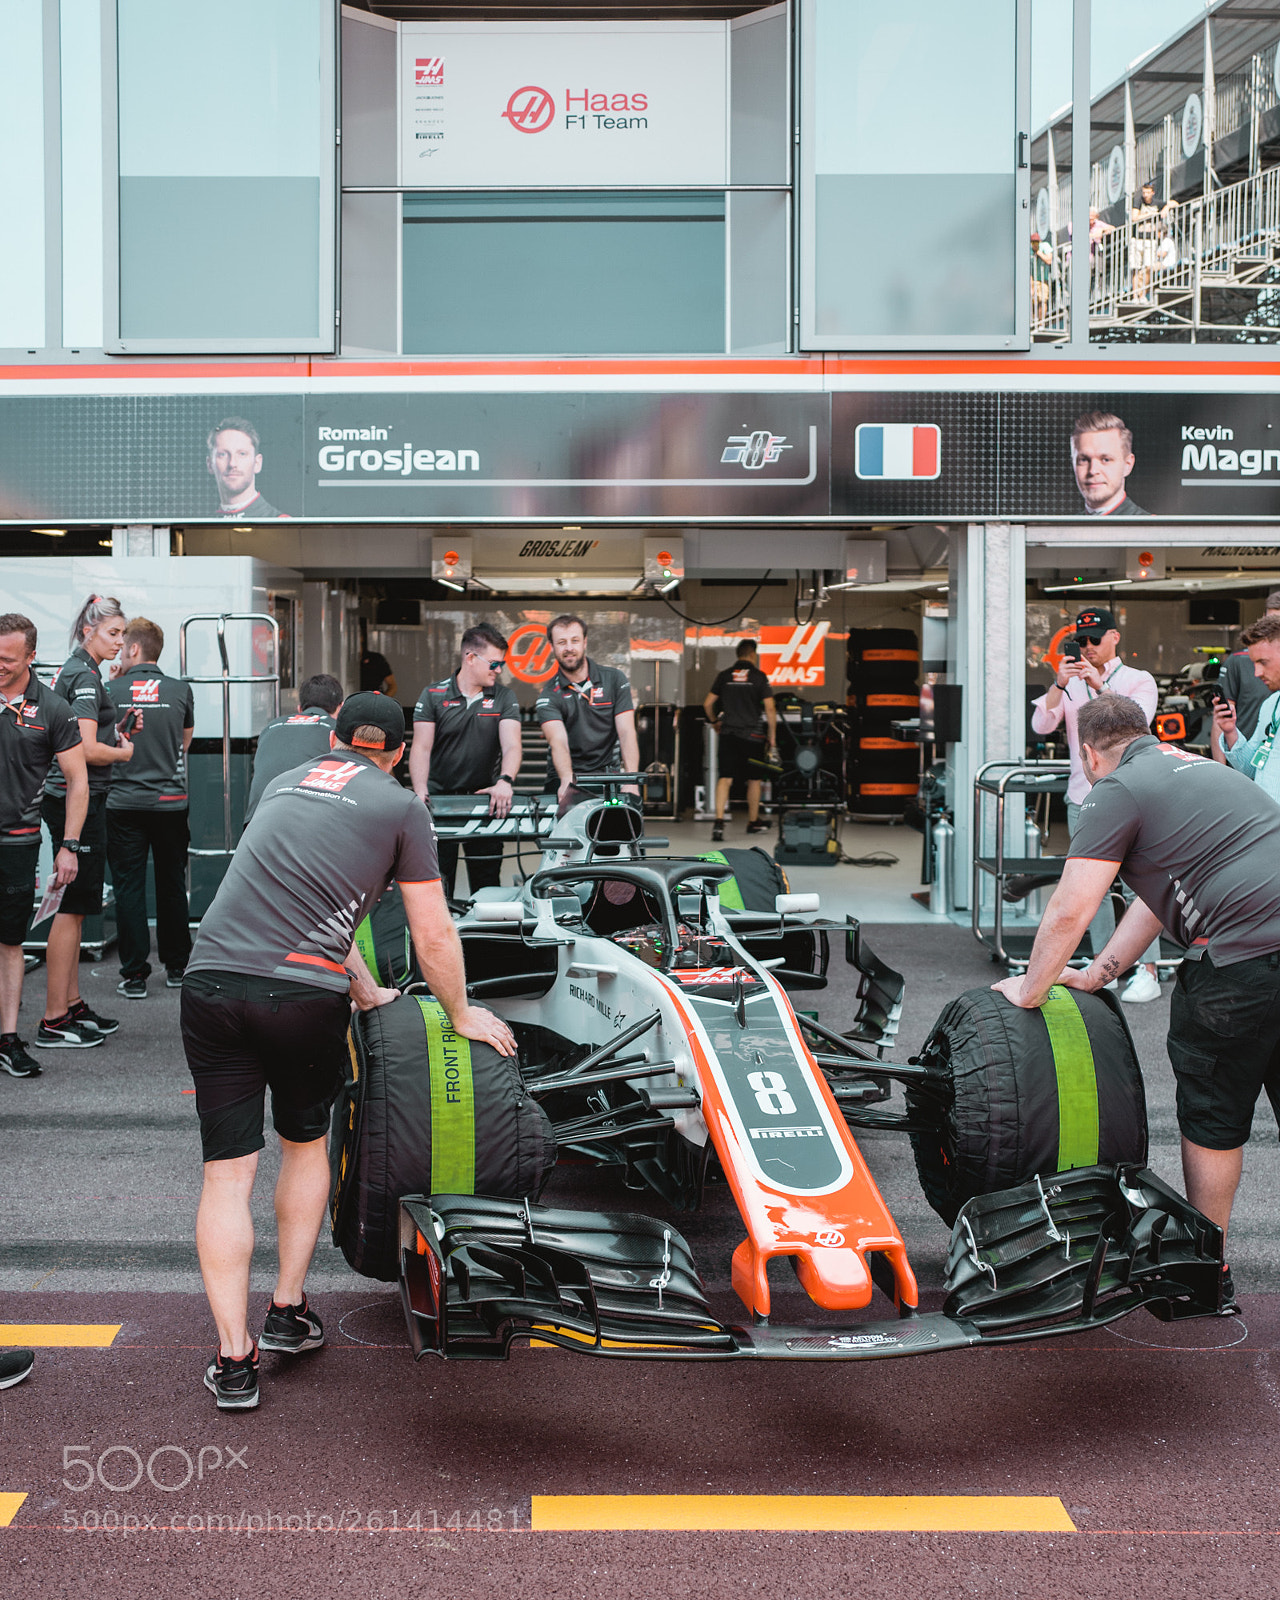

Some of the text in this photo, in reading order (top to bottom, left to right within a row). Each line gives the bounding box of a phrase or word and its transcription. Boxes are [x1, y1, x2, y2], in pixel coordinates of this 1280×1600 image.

[565, 88, 649, 112] Haas
[565, 114, 649, 130] F1 Team
[415, 132, 445, 140] PIRELLI
[318, 425, 388, 441] Romain
[1181, 424, 1234, 441] Kevin
[318, 442, 480, 476] Grosjean
[518, 540, 594, 557] GROSJEAN
[767, 666, 825, 683] HAAS
[300, 778, 347, 790] HAAS
[294, 787, 341, 800] Automation
[569, 983, 611, 1021] RICHARD MILLE
[443, 1046, 461, 1104] FRONT
[746, 1071, 797, 1115] 8
[749, 1126, 824, 1139] PIRELLI
